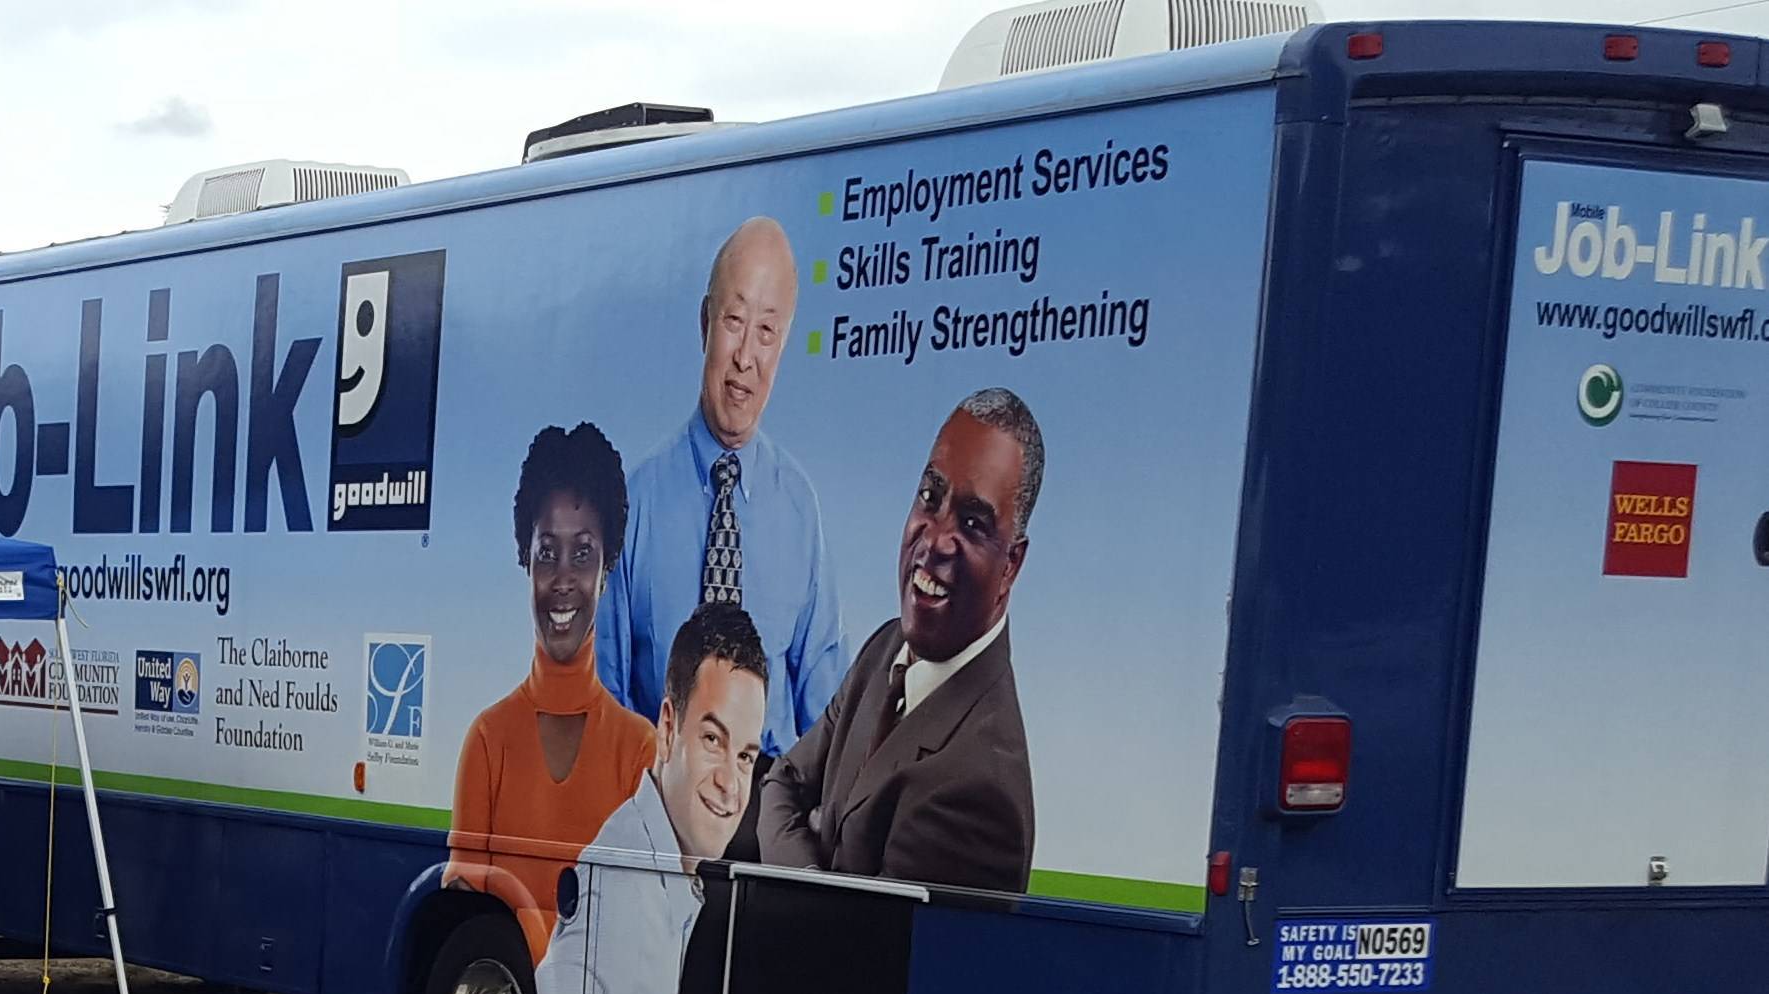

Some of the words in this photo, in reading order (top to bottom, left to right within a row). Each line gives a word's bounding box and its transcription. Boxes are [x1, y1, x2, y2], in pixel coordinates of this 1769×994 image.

[842, 154, 1025, 228] Employment
[1032, 140, 1170, 196] Services
[1571, 202, 1606, 220] Mobile
[836, 242, 911, 291] Skills
[921, 229, 1041, 284] Training
[1534, 201, 1769, 290] Job-Link
[831, 311, 924, 366] Family
[930, 290, 1150, 357] Strengthening
[333, 470, 427, 521] goodwill
[1614, 495, 1690, 517] WELLS
[1613, 522, 1686, 545] FARGO
[137, 657, 172, 680] United
[217, 637, 247, 666] The
[252, 638, 329, 670] Claiborne
[150, 681, 172, 709] Way
[216, 678, 243, 706] and
[248, 679, 280, 709] Ned
[285, 681, 339, 713] Foulds
[216, 716, 304, 751] Foundation
[1280, 925, 1338, 942] SAFETY
[1342, 924, 1356, 941] IS
[1282, 946, 1307, 962] MY
[1313, 944, 1354, 961] GOAL
[1277, 962, 1425, 989] 1-888-550-7233
